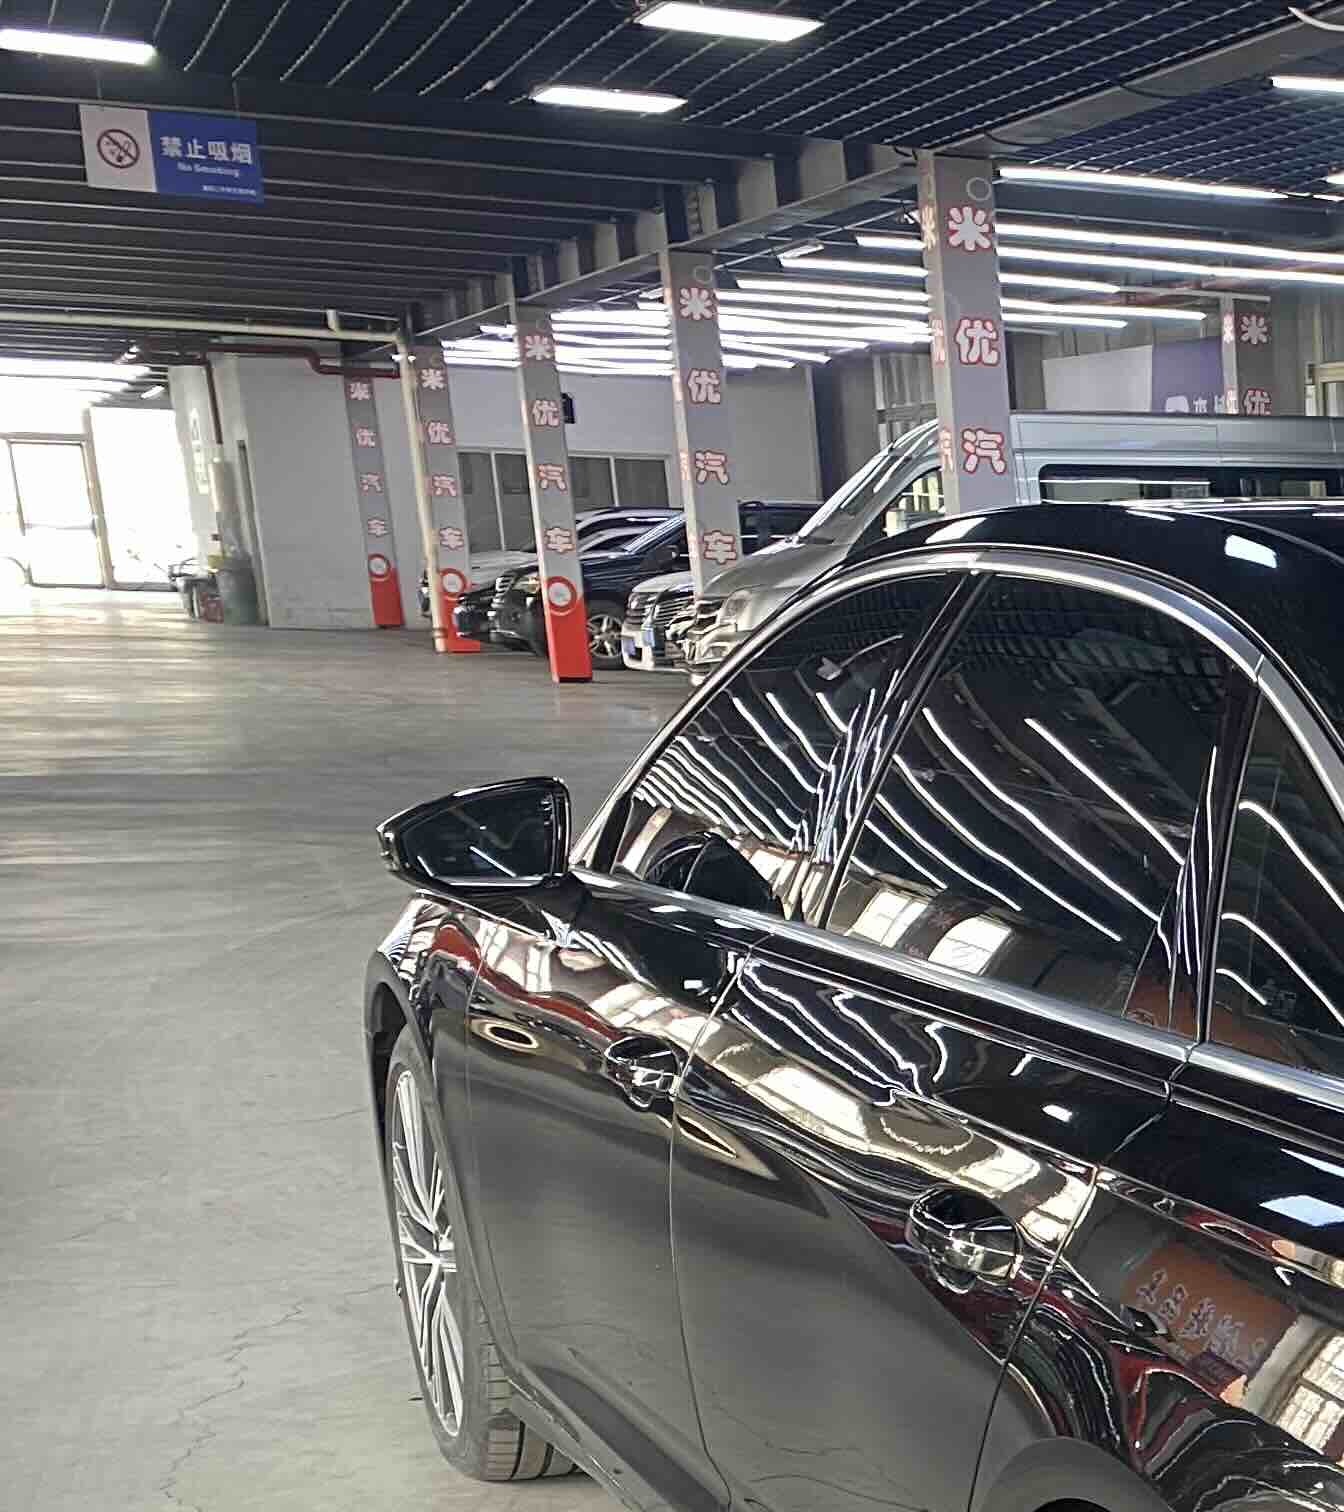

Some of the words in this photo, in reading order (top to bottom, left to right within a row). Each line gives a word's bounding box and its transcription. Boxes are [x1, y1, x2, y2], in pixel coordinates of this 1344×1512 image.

[159, 135, 253, 165] 禁止吸烟
[525, 334, 575, 552] 米优汽车
[679, 285, 737, 565] 米优汽车
